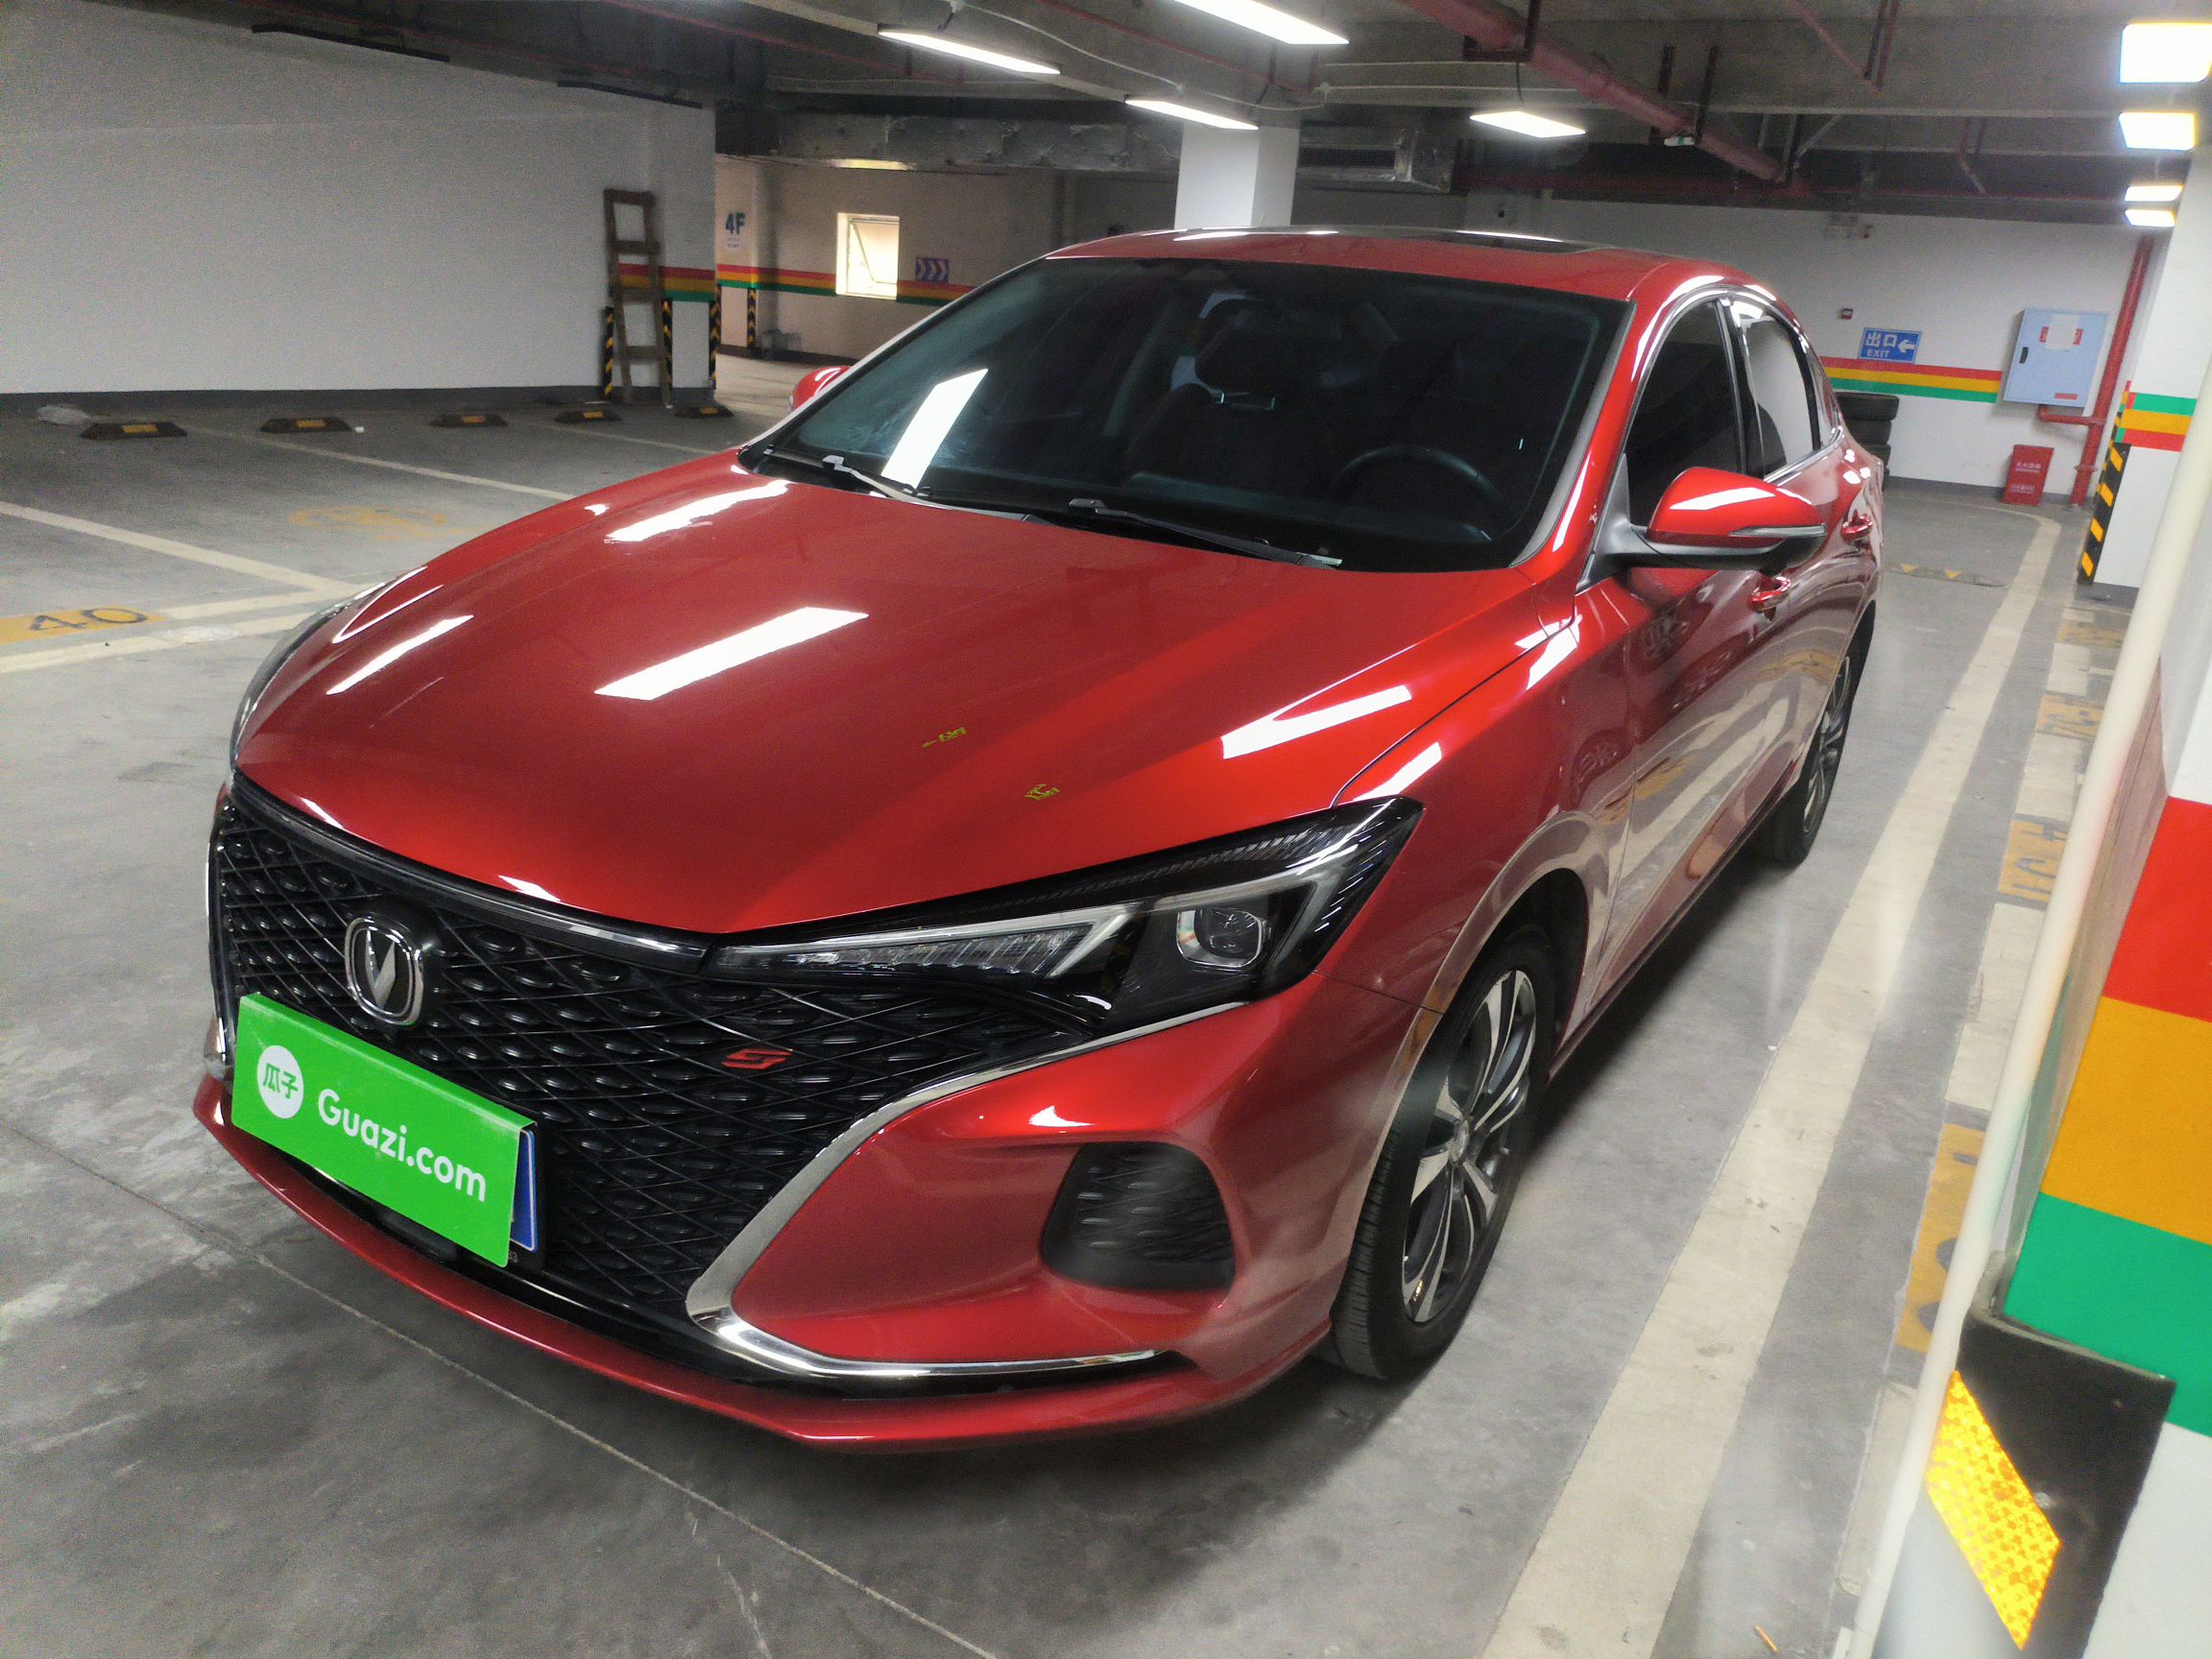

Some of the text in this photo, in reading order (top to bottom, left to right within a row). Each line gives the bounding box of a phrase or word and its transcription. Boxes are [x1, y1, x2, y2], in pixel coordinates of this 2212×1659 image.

[725, 212, 746, 235] 4F
[1865, 331, 1898, 348] 出口
[1866, 348, 1890, 358] EXIT
[262, 1062, 300, 1100] 瓜子
[317, 1088, 487, 1203] Guazi.com
